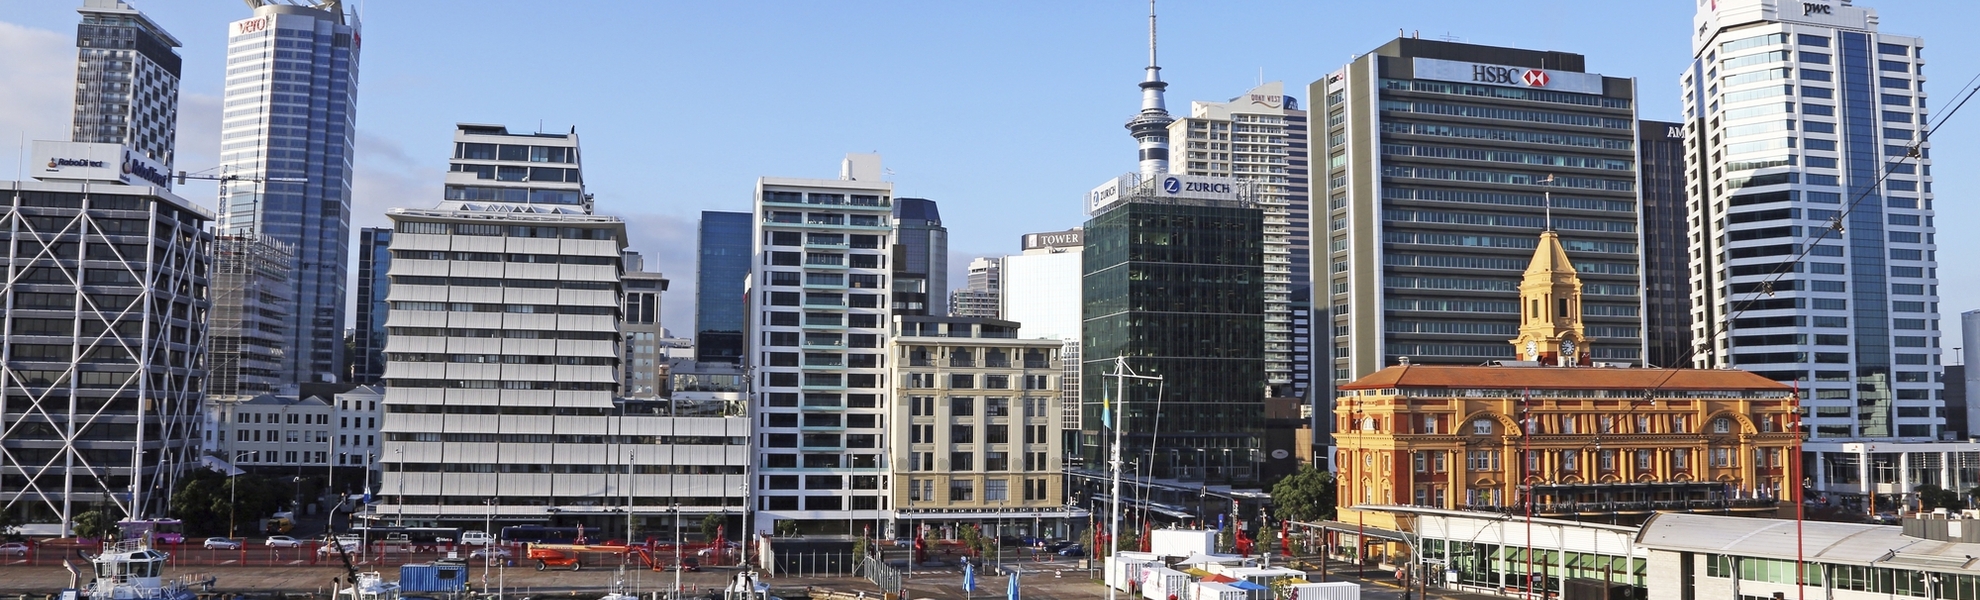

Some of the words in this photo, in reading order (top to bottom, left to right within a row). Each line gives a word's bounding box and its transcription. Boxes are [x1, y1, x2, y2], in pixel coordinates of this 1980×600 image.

[1803, 2, 1831, 16] pwc
[238, 18, 266, 34] vero
[1472, 64, 1520, 85] HSBC
[58, 158, 104, 168] RaboDirect
[1100, 185, 1117, 201] ZURICH
[1185, 181, 1230, 194] ZURICH
[1041, 233, 1079, 245] TOWER
